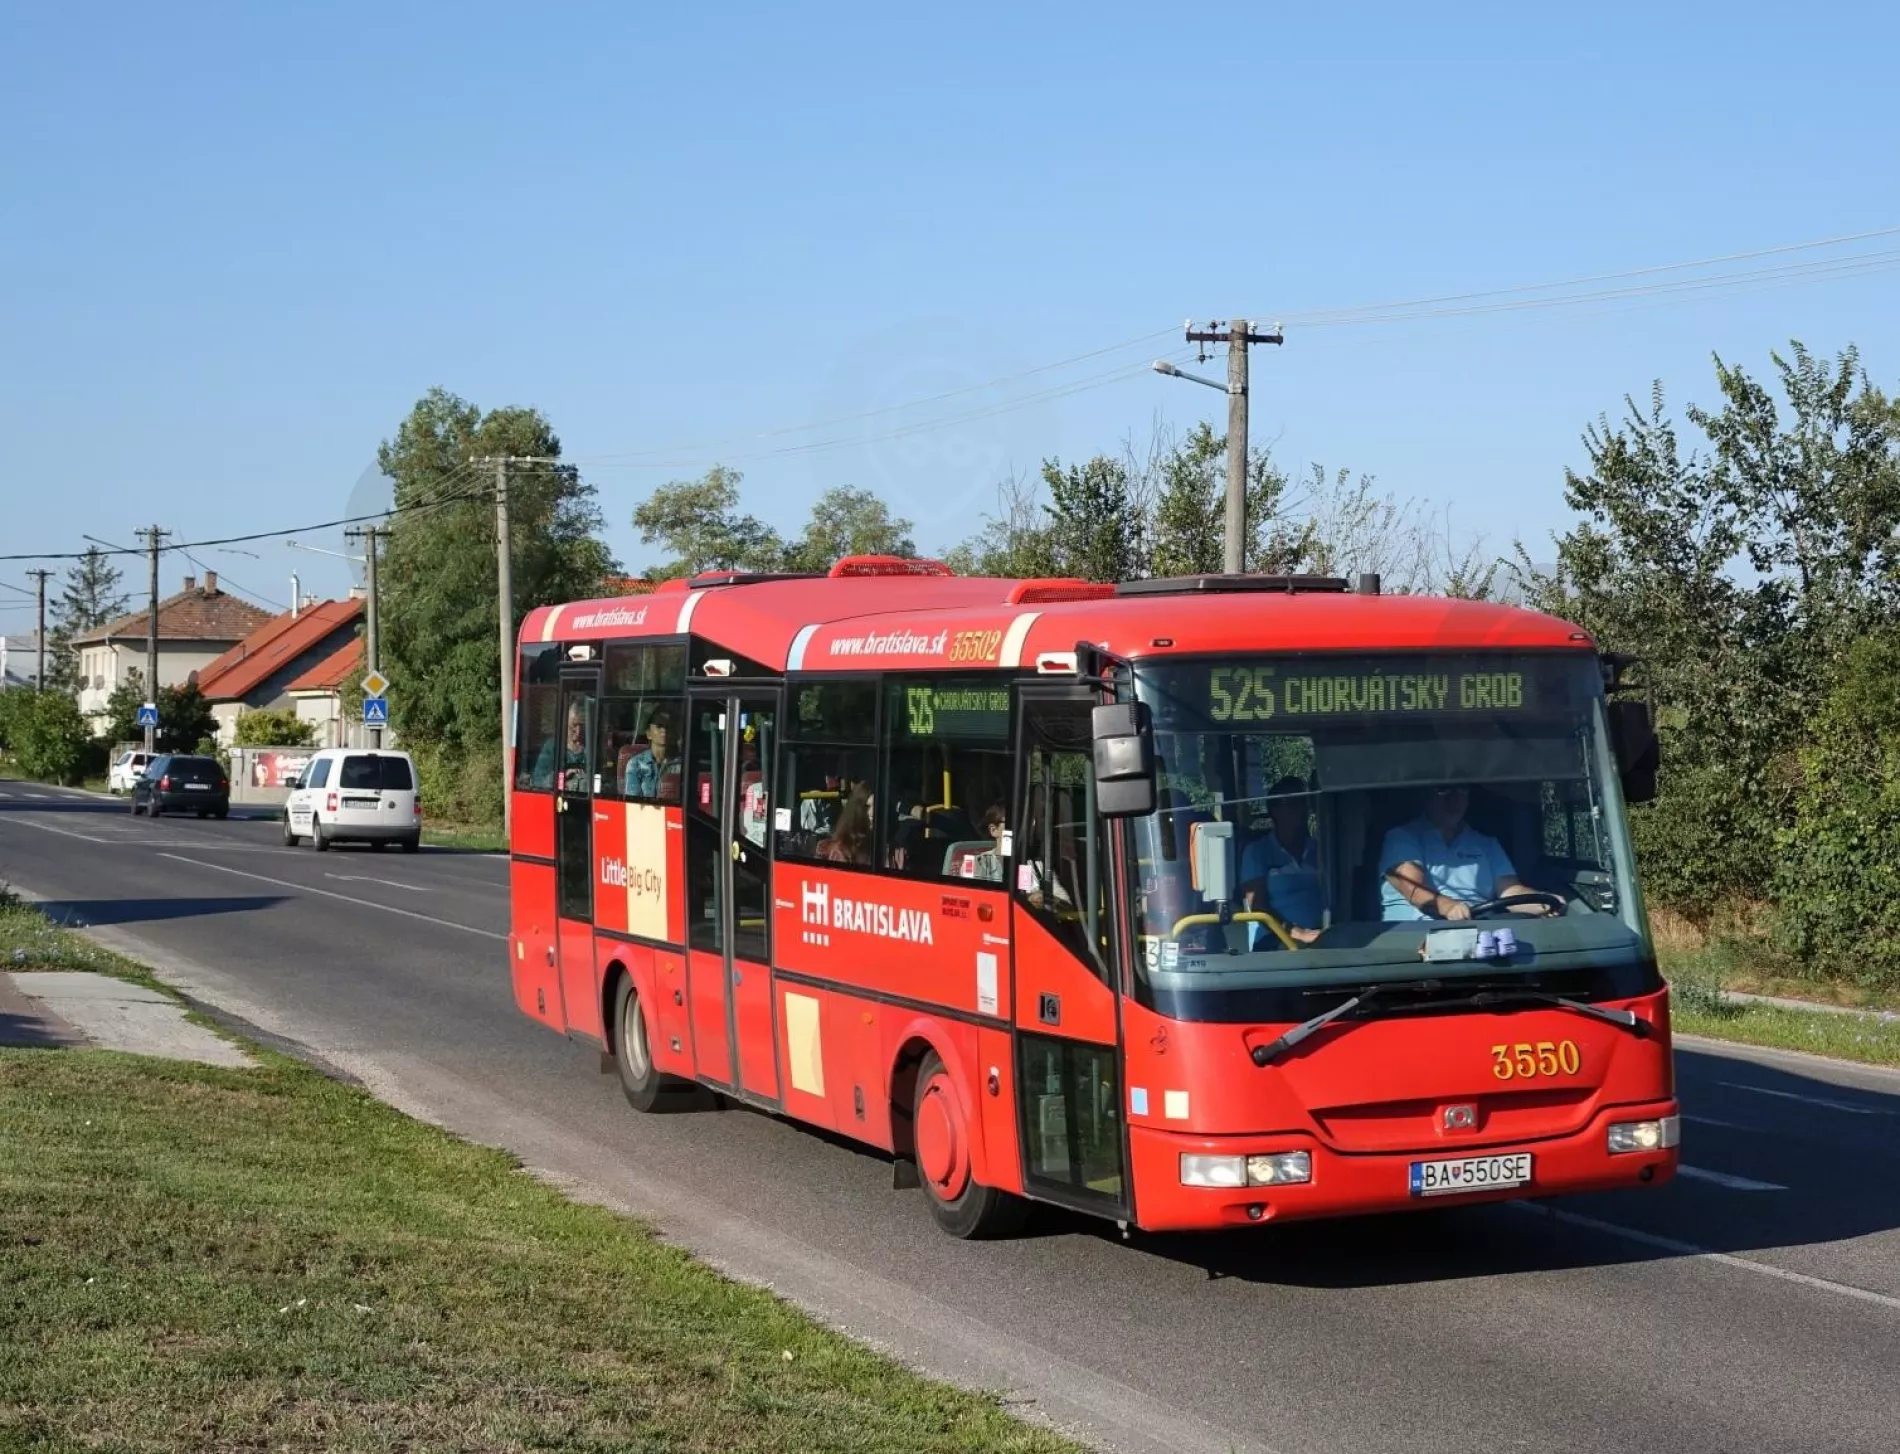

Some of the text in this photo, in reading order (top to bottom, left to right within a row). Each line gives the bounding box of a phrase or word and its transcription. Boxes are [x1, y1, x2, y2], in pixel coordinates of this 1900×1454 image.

[829, 628, 1002, 662] www.bratislava.sk 35502
[907, 688, 934, 734] 525
[1210, 667, 1523, 721] 525 CHORVÁTSKY GROB
[601, 856, 662, 904] Little Big City
[832, 896, 934, 945] BRATISLAVA
[1490, 1040, 1581, 1080] 3550
[1425, 1156, 1528, 1187] BA 550SE
